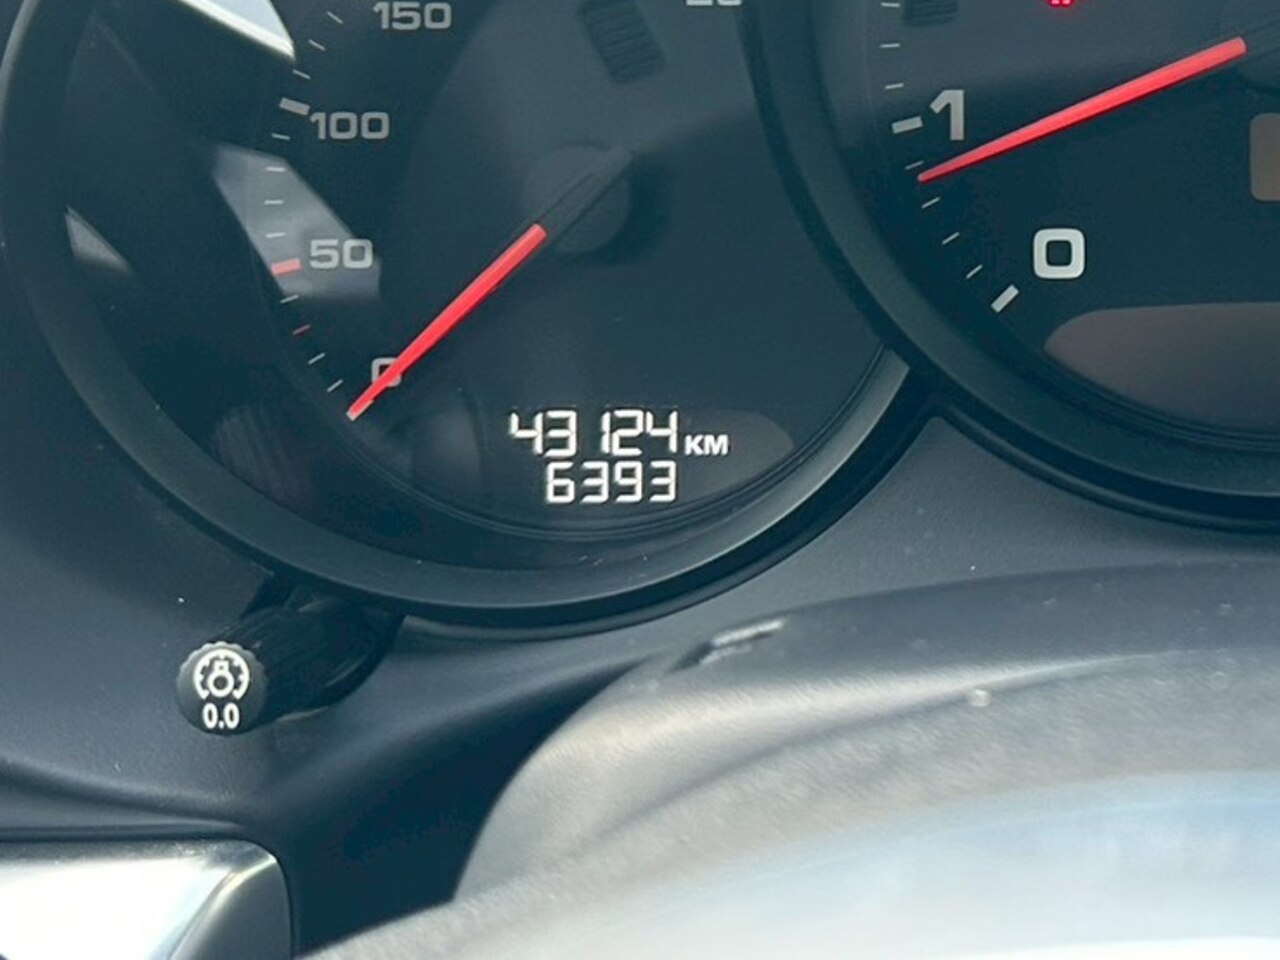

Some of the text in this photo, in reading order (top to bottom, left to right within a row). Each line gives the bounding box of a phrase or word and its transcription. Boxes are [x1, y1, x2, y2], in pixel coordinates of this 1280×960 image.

[373, 1, 451, 29] 150
[309, 112, 389, 139] 100
[930, 90, 964, 140] 1
[310, 239, 372, 268] 50
[1034, 229, 1084, 278] 0
[510, 410, 728, 457] 43124 KM
[547, 461, 676, 503] 6393
[202, 702, 240, 729] 0.0
